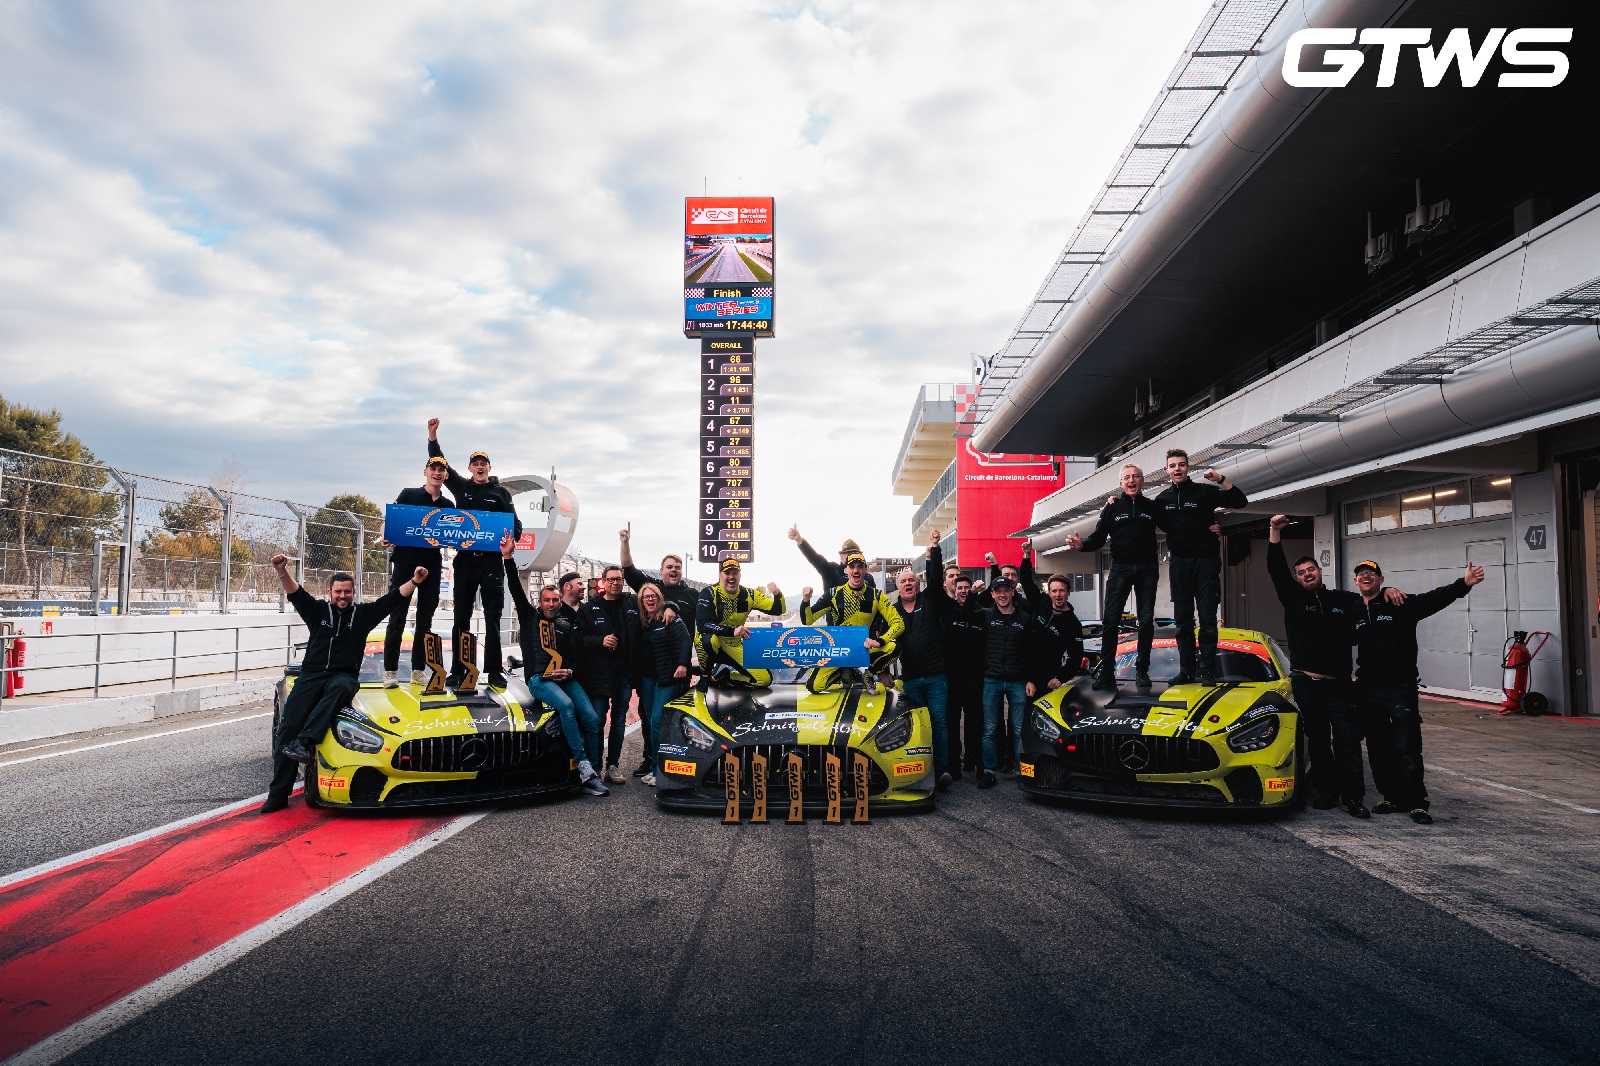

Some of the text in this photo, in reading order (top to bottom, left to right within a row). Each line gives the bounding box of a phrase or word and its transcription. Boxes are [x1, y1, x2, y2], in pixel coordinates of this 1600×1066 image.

[714, 290, 741, 298] Finish
[696, 300, 738, 312] WINTER
[716, 305, 758, 316] SERIES
[726, 320, 768, 330] 17:44:40
[708, 358, 714, 369] 1
[707, 379, 715, 390] 2
[707, 400, 715, 410] 3
[706, 420, 715, 431] 4
[707, 441, 715, 452] 5
[707, 462, 714, 472] 6
[706, 482, 714, 493] 7
[706, 503, 713, 514] 8
[405, 526, 495, 540] 2026 WINNER
[706, 524, 713, 535] 9
[1530, 530, 1544, 545] 47
[702, 545, 717, 556] 10
[1322, 552, 1329, 564] 48
[788, 636, 822, 645] GTWS
[762, 648, 850, 658] 2026 WINNER
[668, 763, 692, 773] PIRELLI
[897, 764, 922, 773] PIRELLI
[726, 763, 734, 801] GTWS
[754, 763, 763, 801] GTWS
[790, 763, 798, 801] GTWS
[855, 763, 864, 801] GTWS
[730, 807, 734, 817] 1
[758, 807, 762, 816] 1
[794, 807, 798, 816] 1
[832, 807, 836, 817] 1
[860, 807, 864, 817] 1
